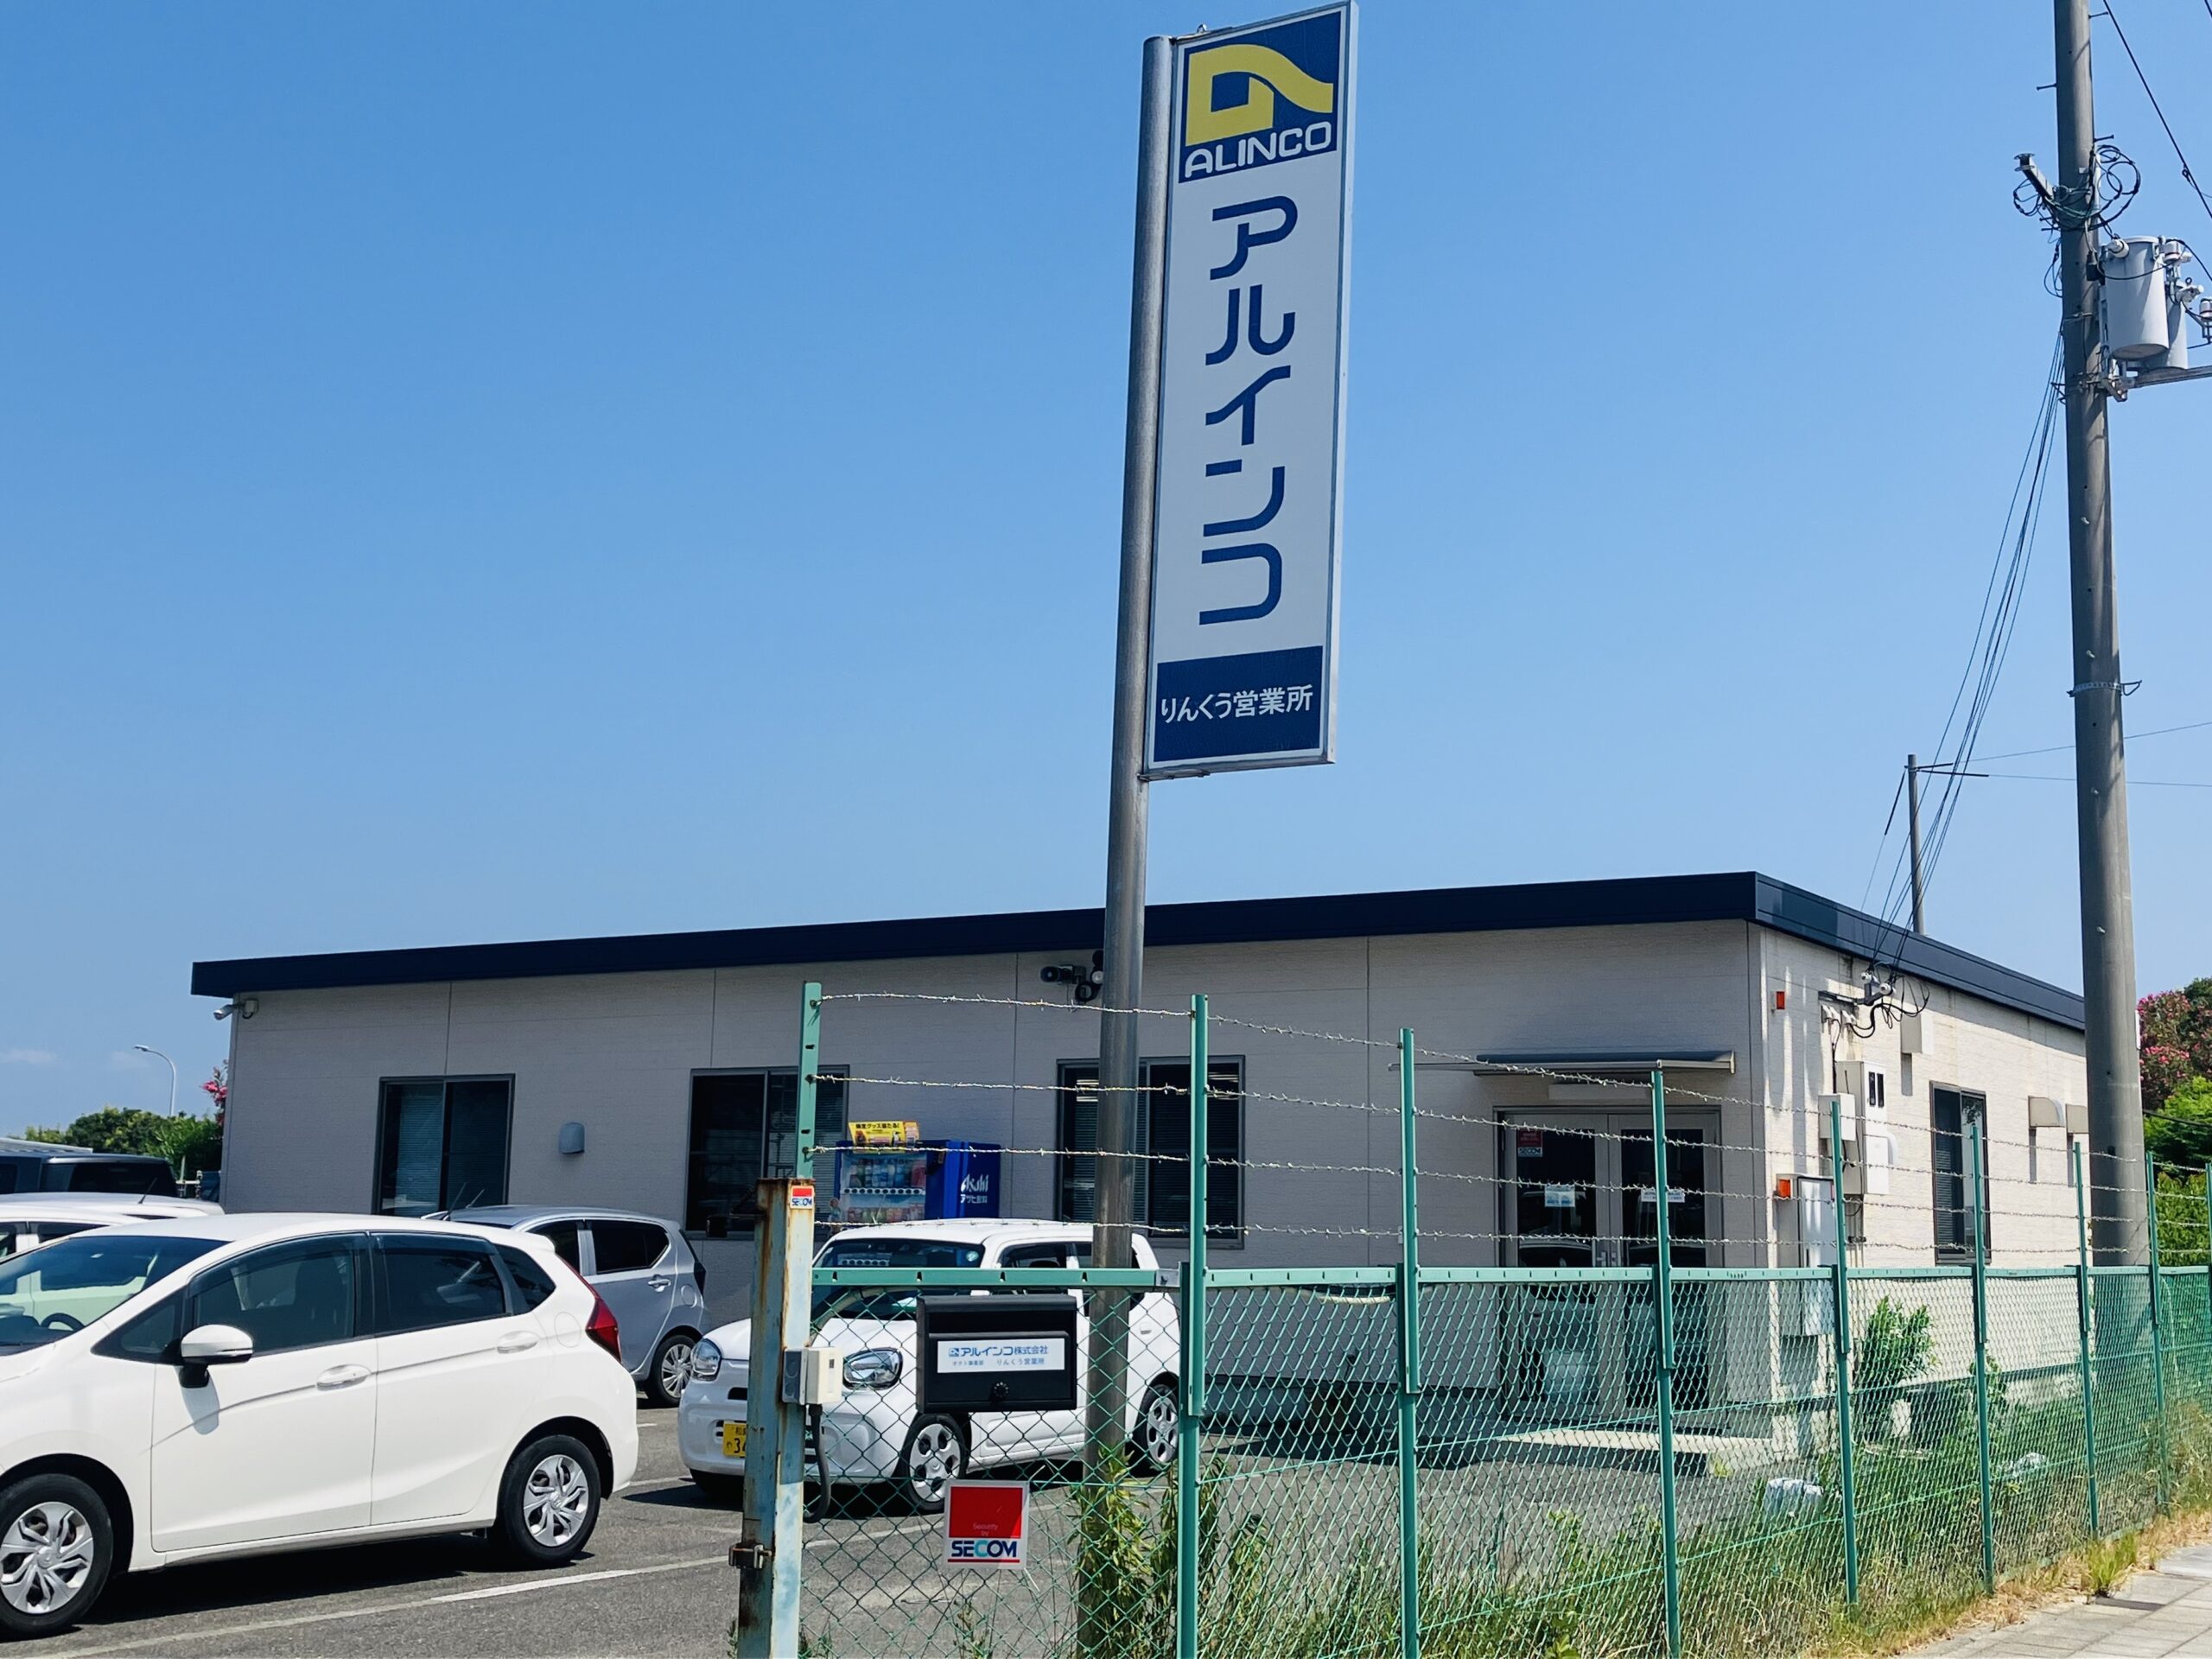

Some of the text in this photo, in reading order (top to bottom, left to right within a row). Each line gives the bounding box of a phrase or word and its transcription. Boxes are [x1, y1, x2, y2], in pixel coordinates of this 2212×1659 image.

[1184, 120, 1332, 179] ALINCO
[1198, 195, 1299, 626] アルインコ
[1160, 683, 1313, 723] りんくう営業所
[960, 1173, 989, 1193] Asahi
[960, 1345, 1048, 1357] アルインコ株式会社
[951, 1539, 1017, 1558] SECOM
